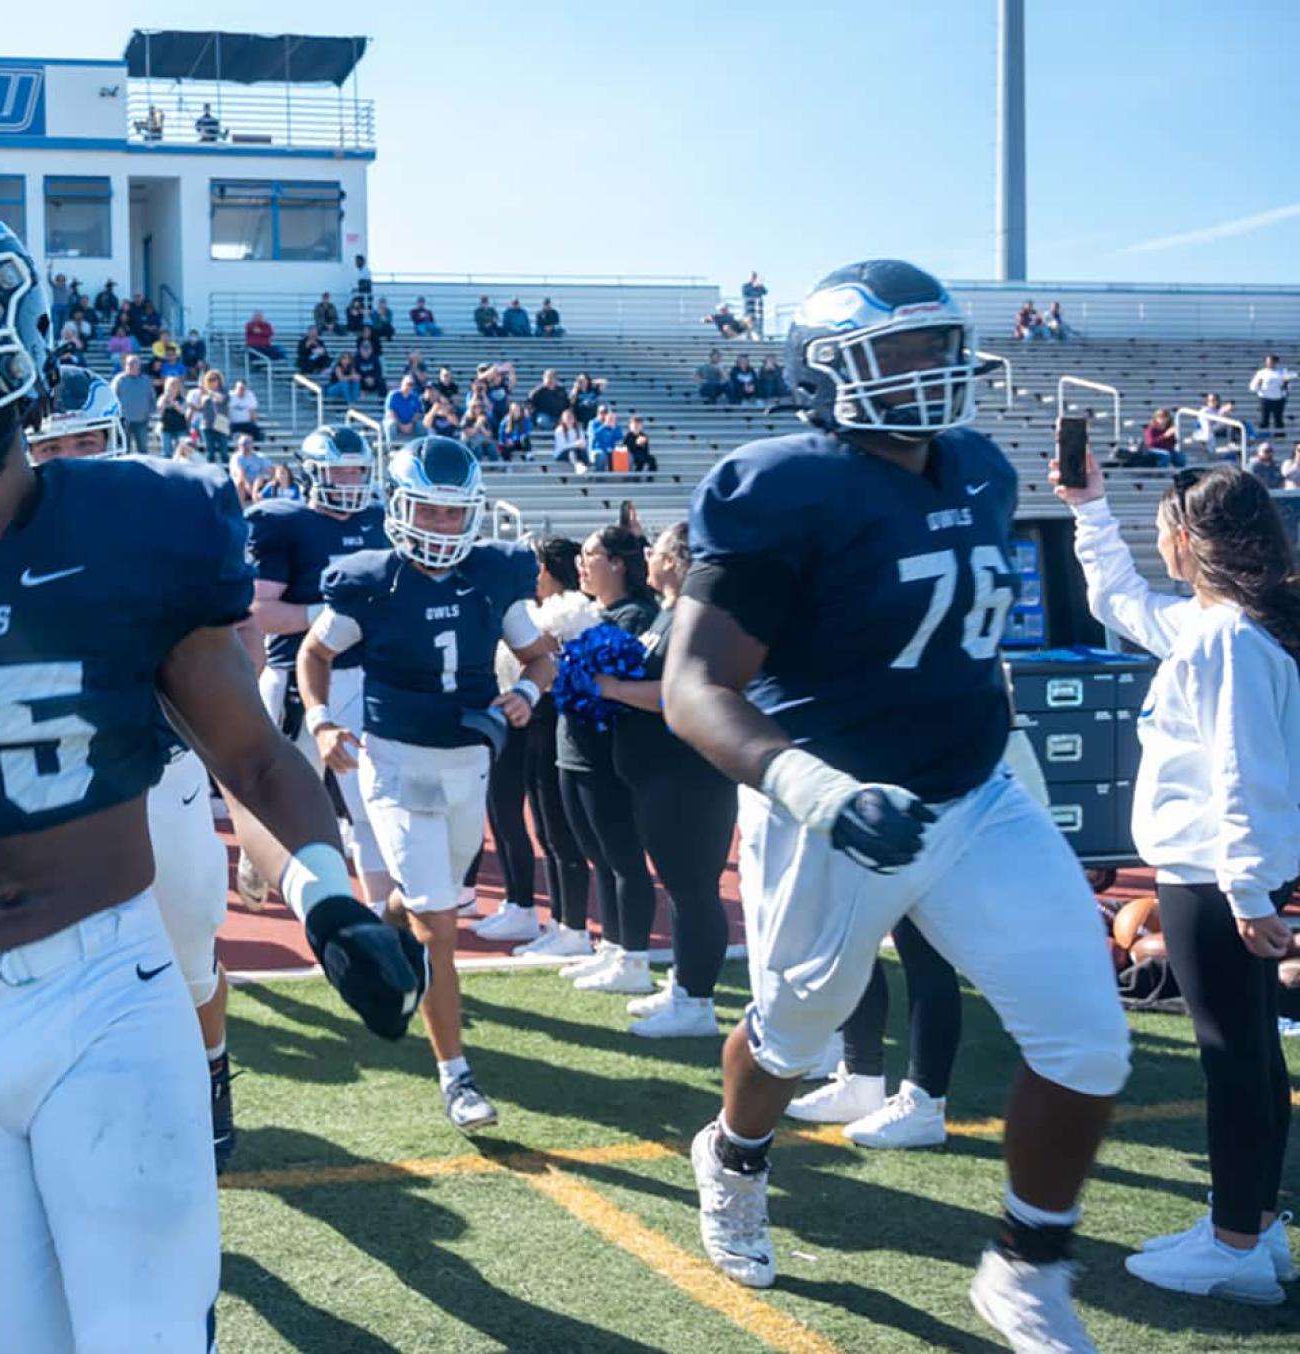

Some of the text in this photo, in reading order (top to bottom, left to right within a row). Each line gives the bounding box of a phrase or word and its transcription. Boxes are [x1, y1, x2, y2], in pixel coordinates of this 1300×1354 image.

[926, 508, 973, 531] OWLS
[425, 605, 460, 620] OWLS
[890, 545, 1015, 669] 76
[434, 630, 458, 692] 1
